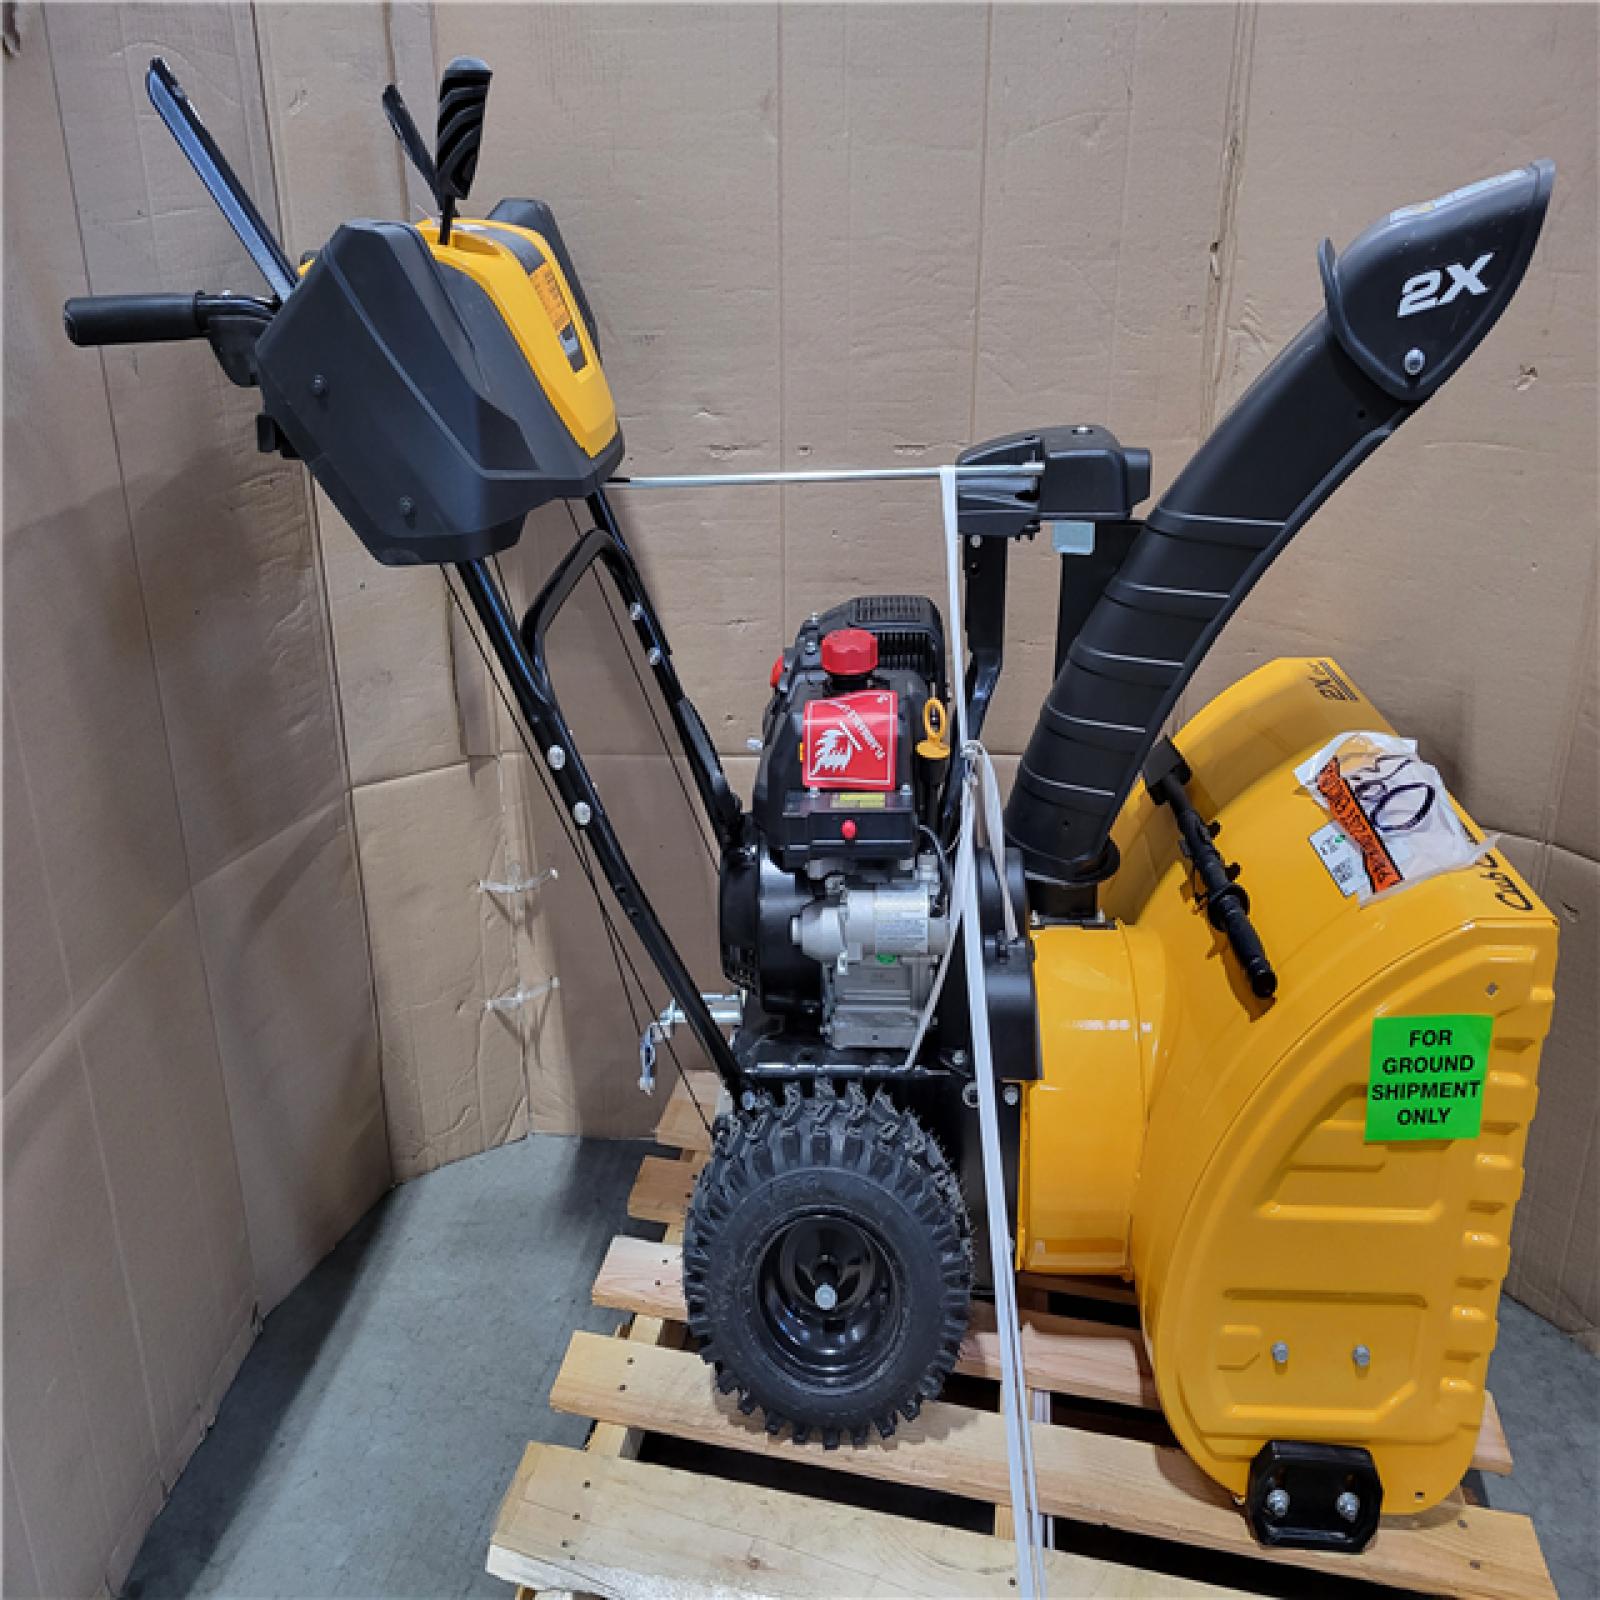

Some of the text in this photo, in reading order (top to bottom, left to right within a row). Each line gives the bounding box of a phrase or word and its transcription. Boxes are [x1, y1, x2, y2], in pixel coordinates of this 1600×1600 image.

[1397, 252, 1495, 318] 2X
[1409, 1029, 1453, 1047] FOR
[1382, 1055, 1475, 1075] GROUND
[1372, 1080, 1481, 1101] SHIPMENT
[1397, 1107, 1452, 1125] ONLY
